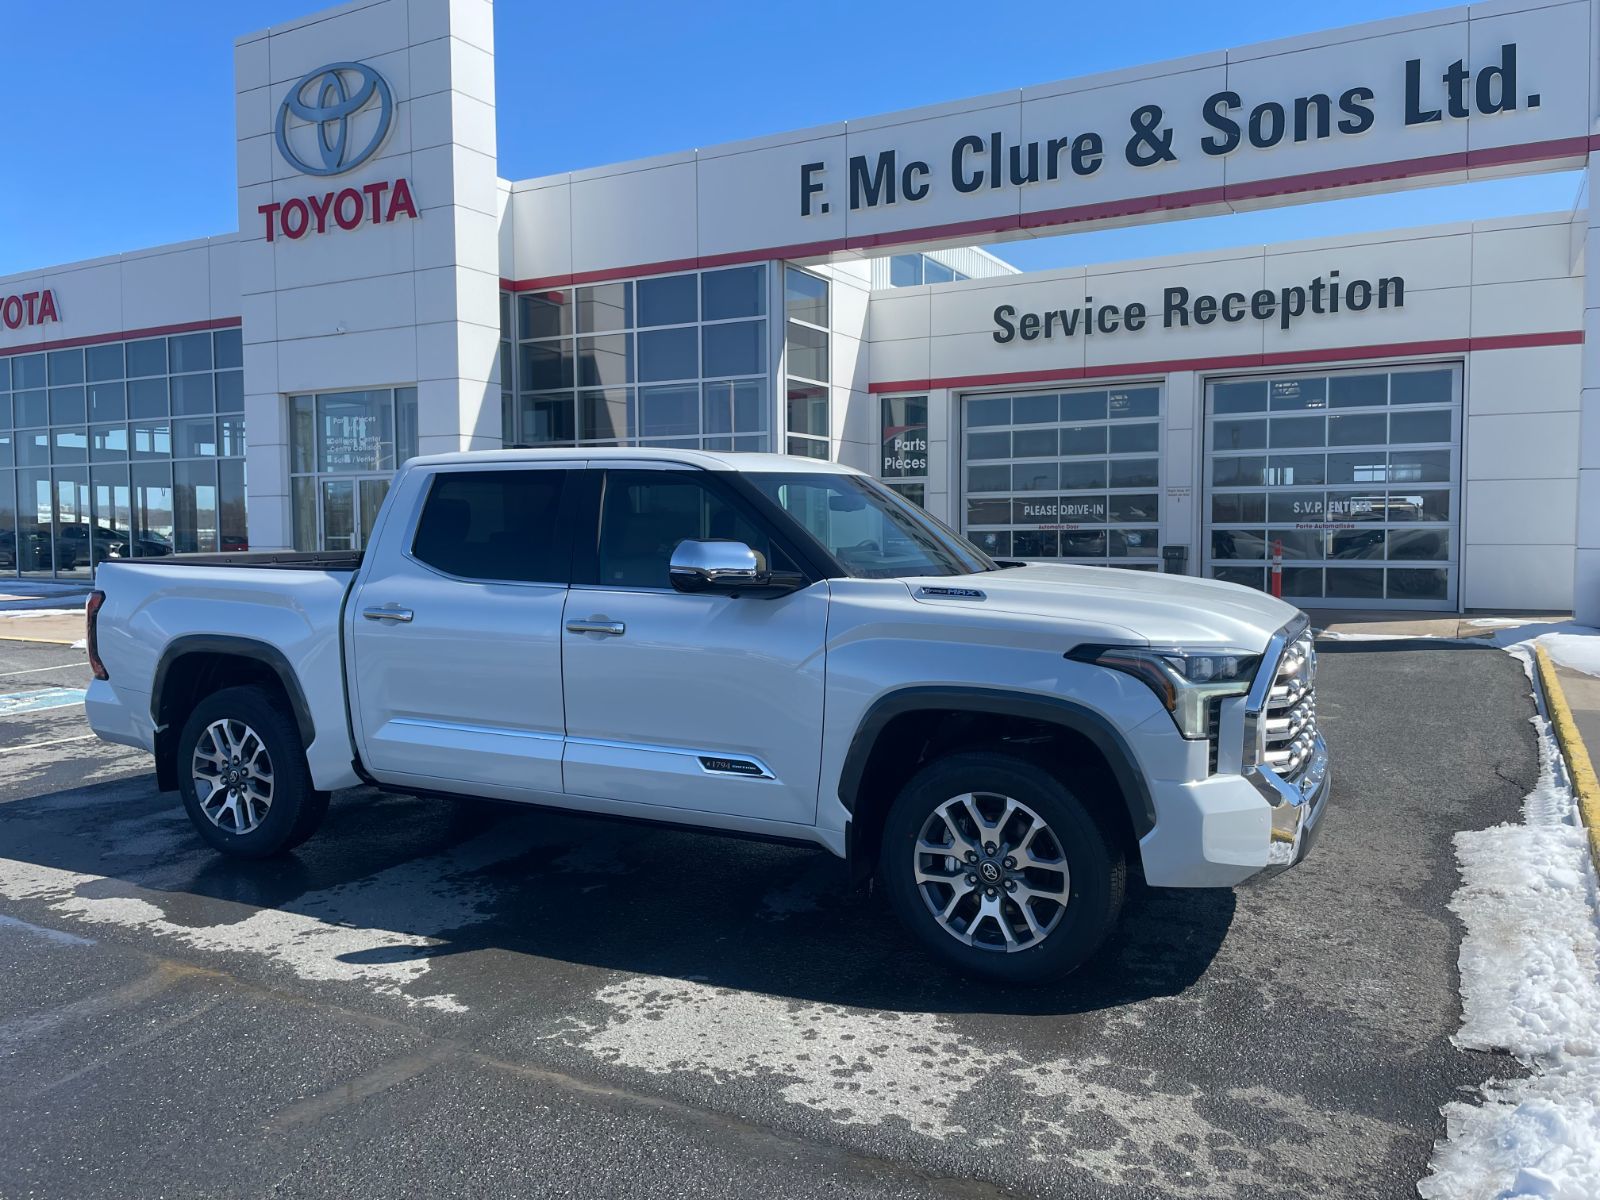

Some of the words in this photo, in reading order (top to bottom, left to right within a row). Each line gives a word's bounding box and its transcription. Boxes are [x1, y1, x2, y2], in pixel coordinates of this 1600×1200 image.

[800, 161, 829, 216] F.
[849, 150, 929, 210] Mc
[951, 131, 1103, 193] Clure
[1125, 104, 1178, 167] &
[1200, 87, 1375, 156] Sons
[1404, 43, 1541, 126] Ltd.
[258, 178, 418, 242] TOYOTA
[0, 289, 58, 330] OTA
[992, 296, 1147, 344] Service
[1163, 270, 1406, 330] Reception
[894, 438, 927, 452] Parts
[884, 456, 927, 470] Pièces
[1024, 504, 1057, 516] PLEASE
[1060, 504, 1104, 515] DRIVE-IN
[1293, 501, 1323, 514] S.V.P.
[948, 588, 976, 597] MAX
[712, 761, 731, 770] 1794
